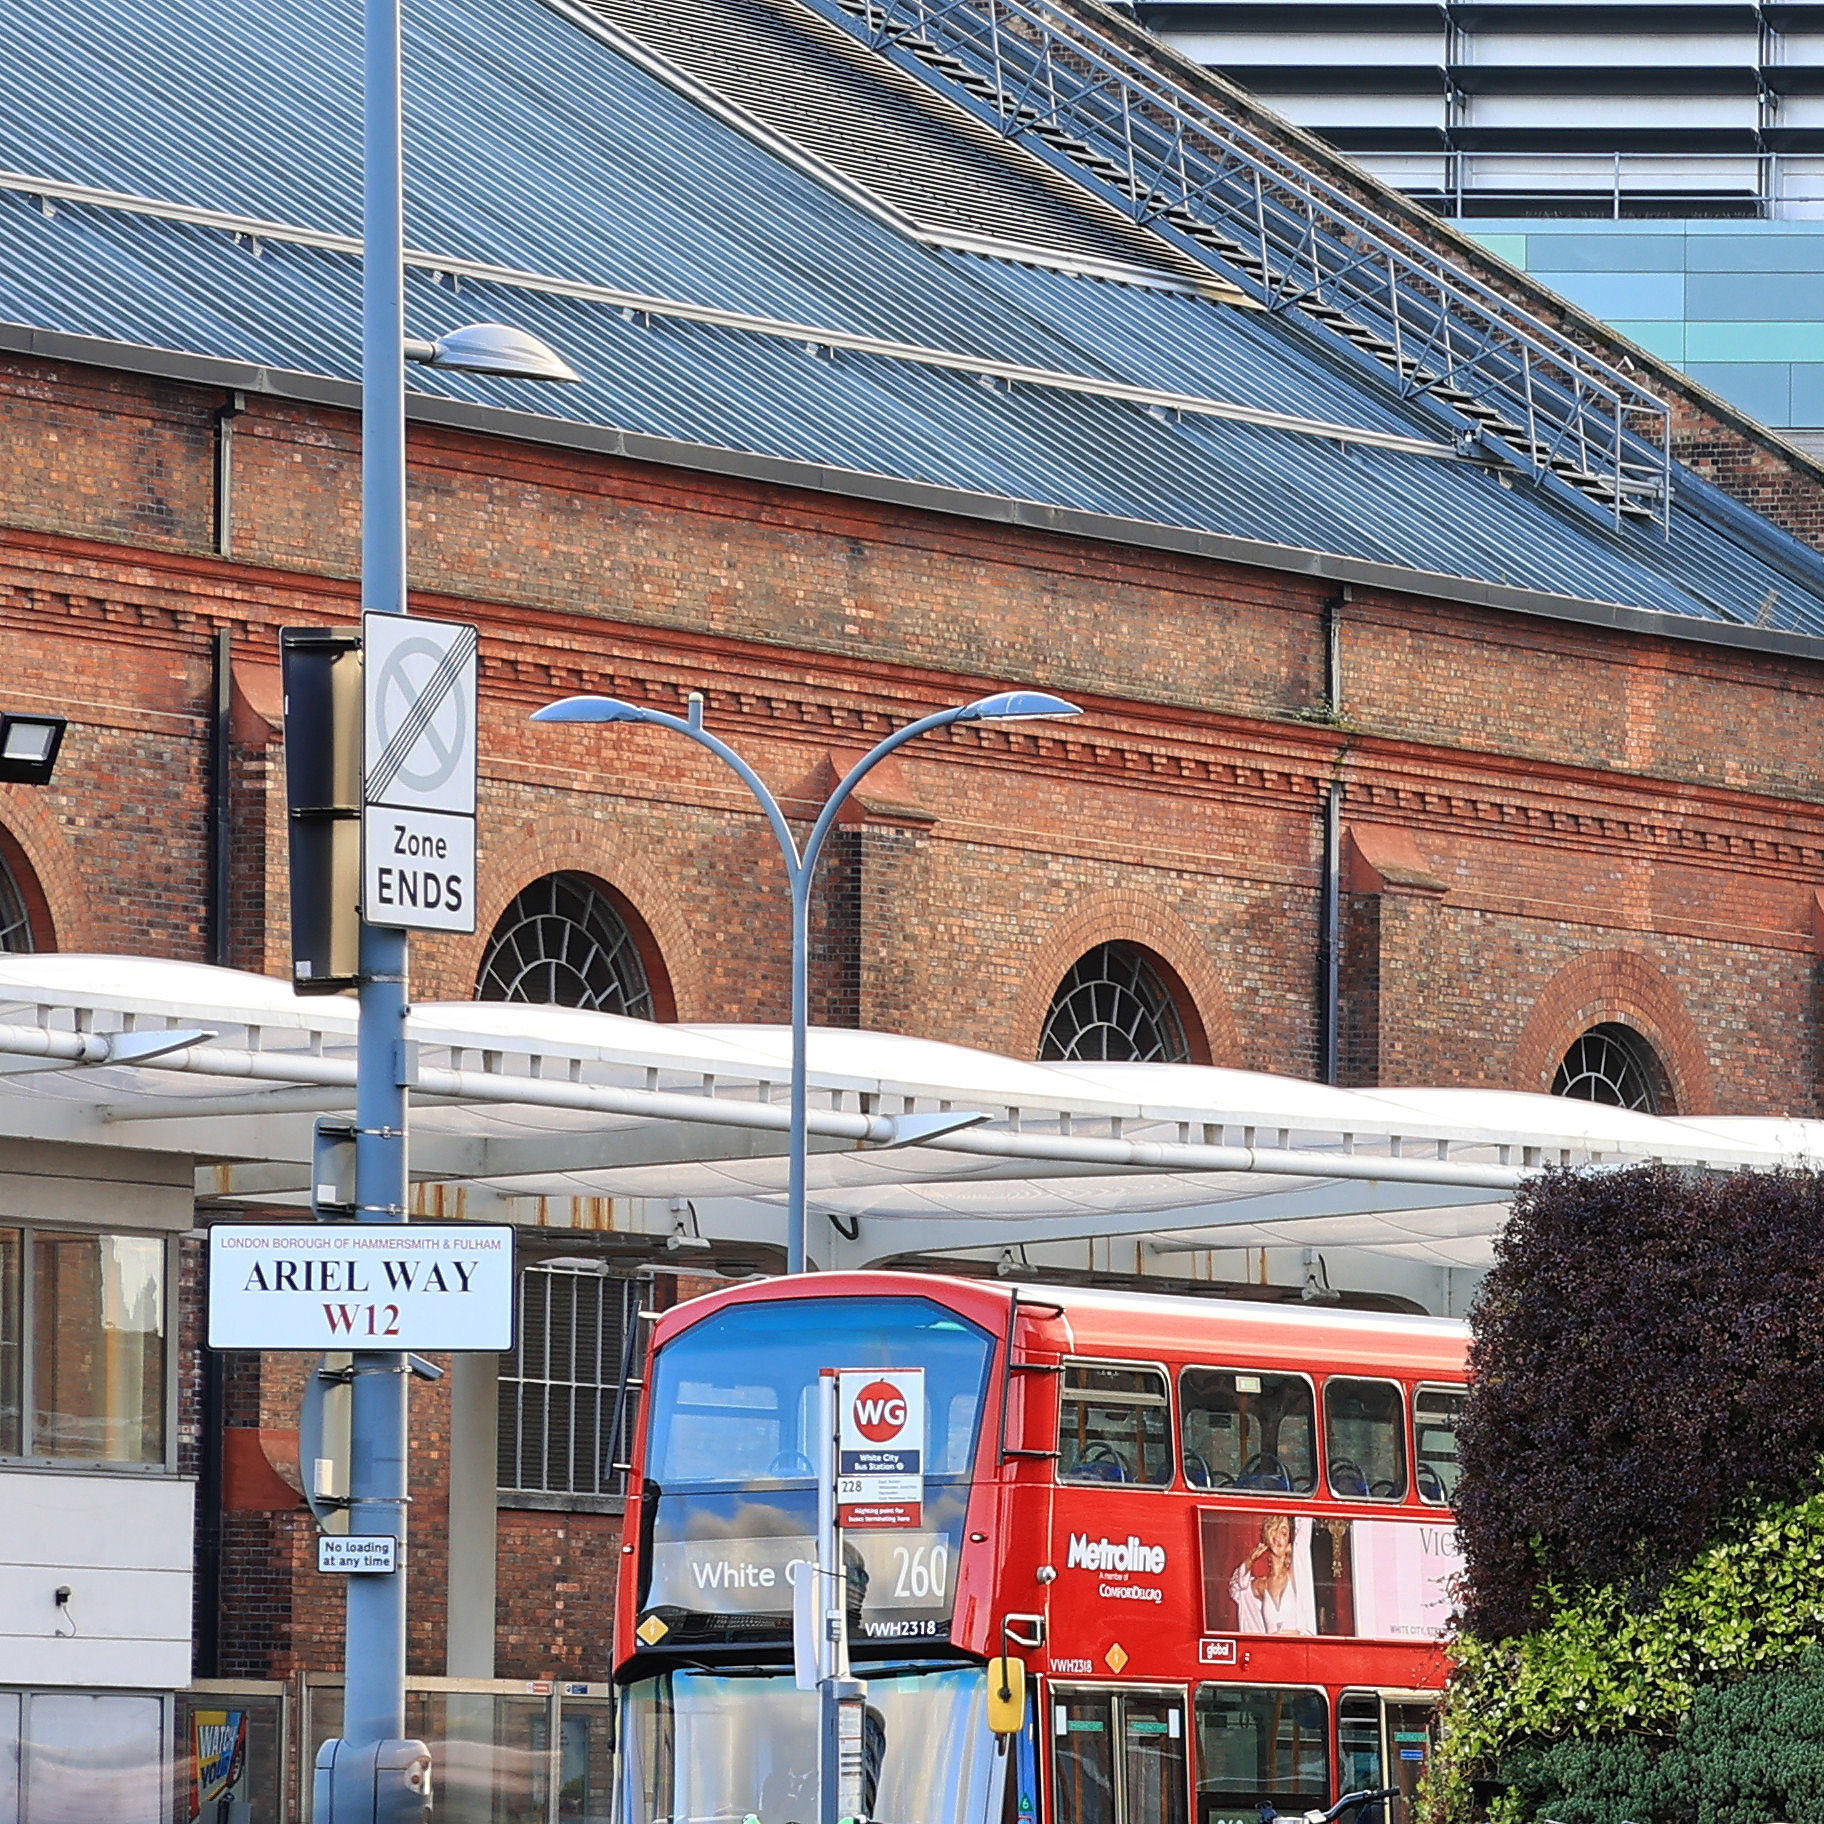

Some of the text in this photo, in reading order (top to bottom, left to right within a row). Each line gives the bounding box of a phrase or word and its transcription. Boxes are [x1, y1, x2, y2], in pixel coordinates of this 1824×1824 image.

[394, 824, 447, 859] Zone
[378, 867, 462, 912] ENDS
[221, 1238, 500, 1250] LONDON BOROUGH OF HAMMERSMITH & FULHAM
[242, 1260, 479, 1292] ARIEL WAY
[321, 1303, 400, 1335] W12
[855, 1399, 906, 1426] WG
[860, 1453, 899, 1463] White City
[854, 1463, 895, 1471] Bus Station
[841, 1480, 863, 1493] 228
[325, 1542, 389, 1554] No loading
[1067, 1532, 1165, 1574] Metroline
[323, 1556, 390, 1568] at any time
[692, 1562, 775, 1589] White
[893, 1544, 947, 1598] 260
[865, 1621, 936, 1637] VWH2318
[1206, 1642, 1229, 1659] global
[1050, 1658, 1092, 1673] VWH2318
